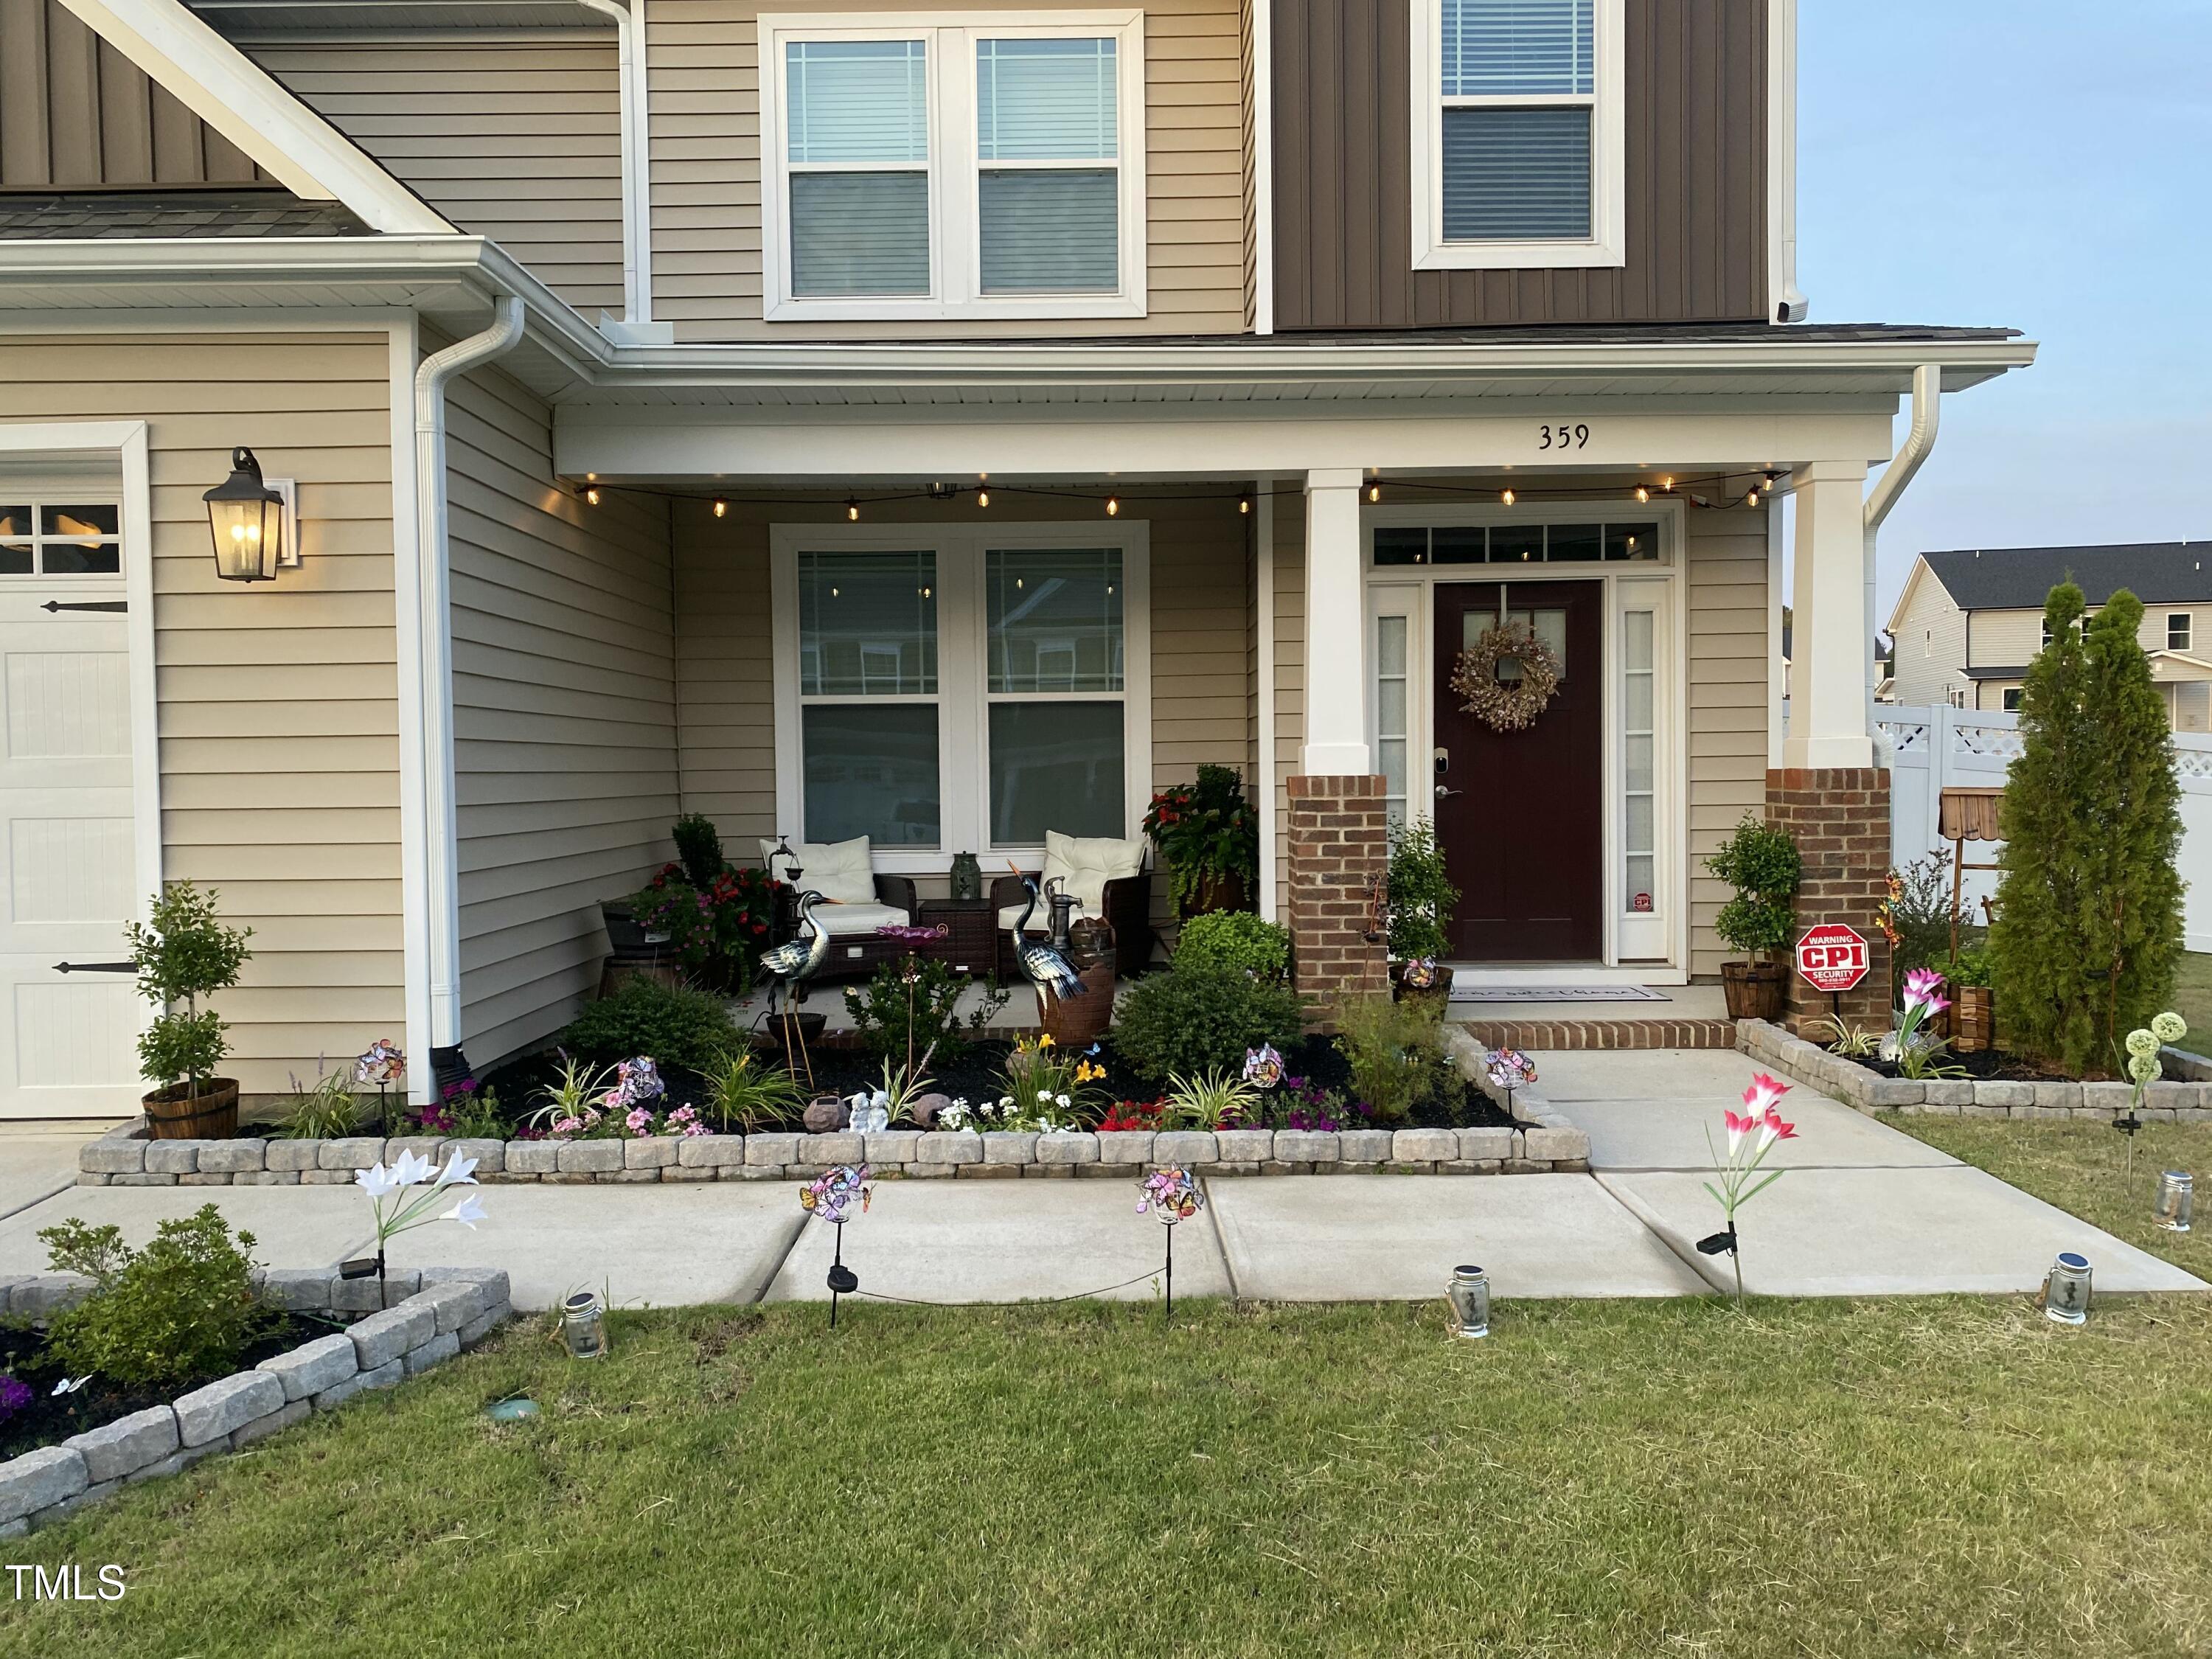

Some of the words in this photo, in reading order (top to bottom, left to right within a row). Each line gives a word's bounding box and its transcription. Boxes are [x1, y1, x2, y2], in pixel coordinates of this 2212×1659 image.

[1539, 424, 1589, 450] 359
[1809, 935, 1853, 945] WARNING
[1802, 946, 1863, 968] CPI
[1812, 970, 1854, 978] SECURITY
